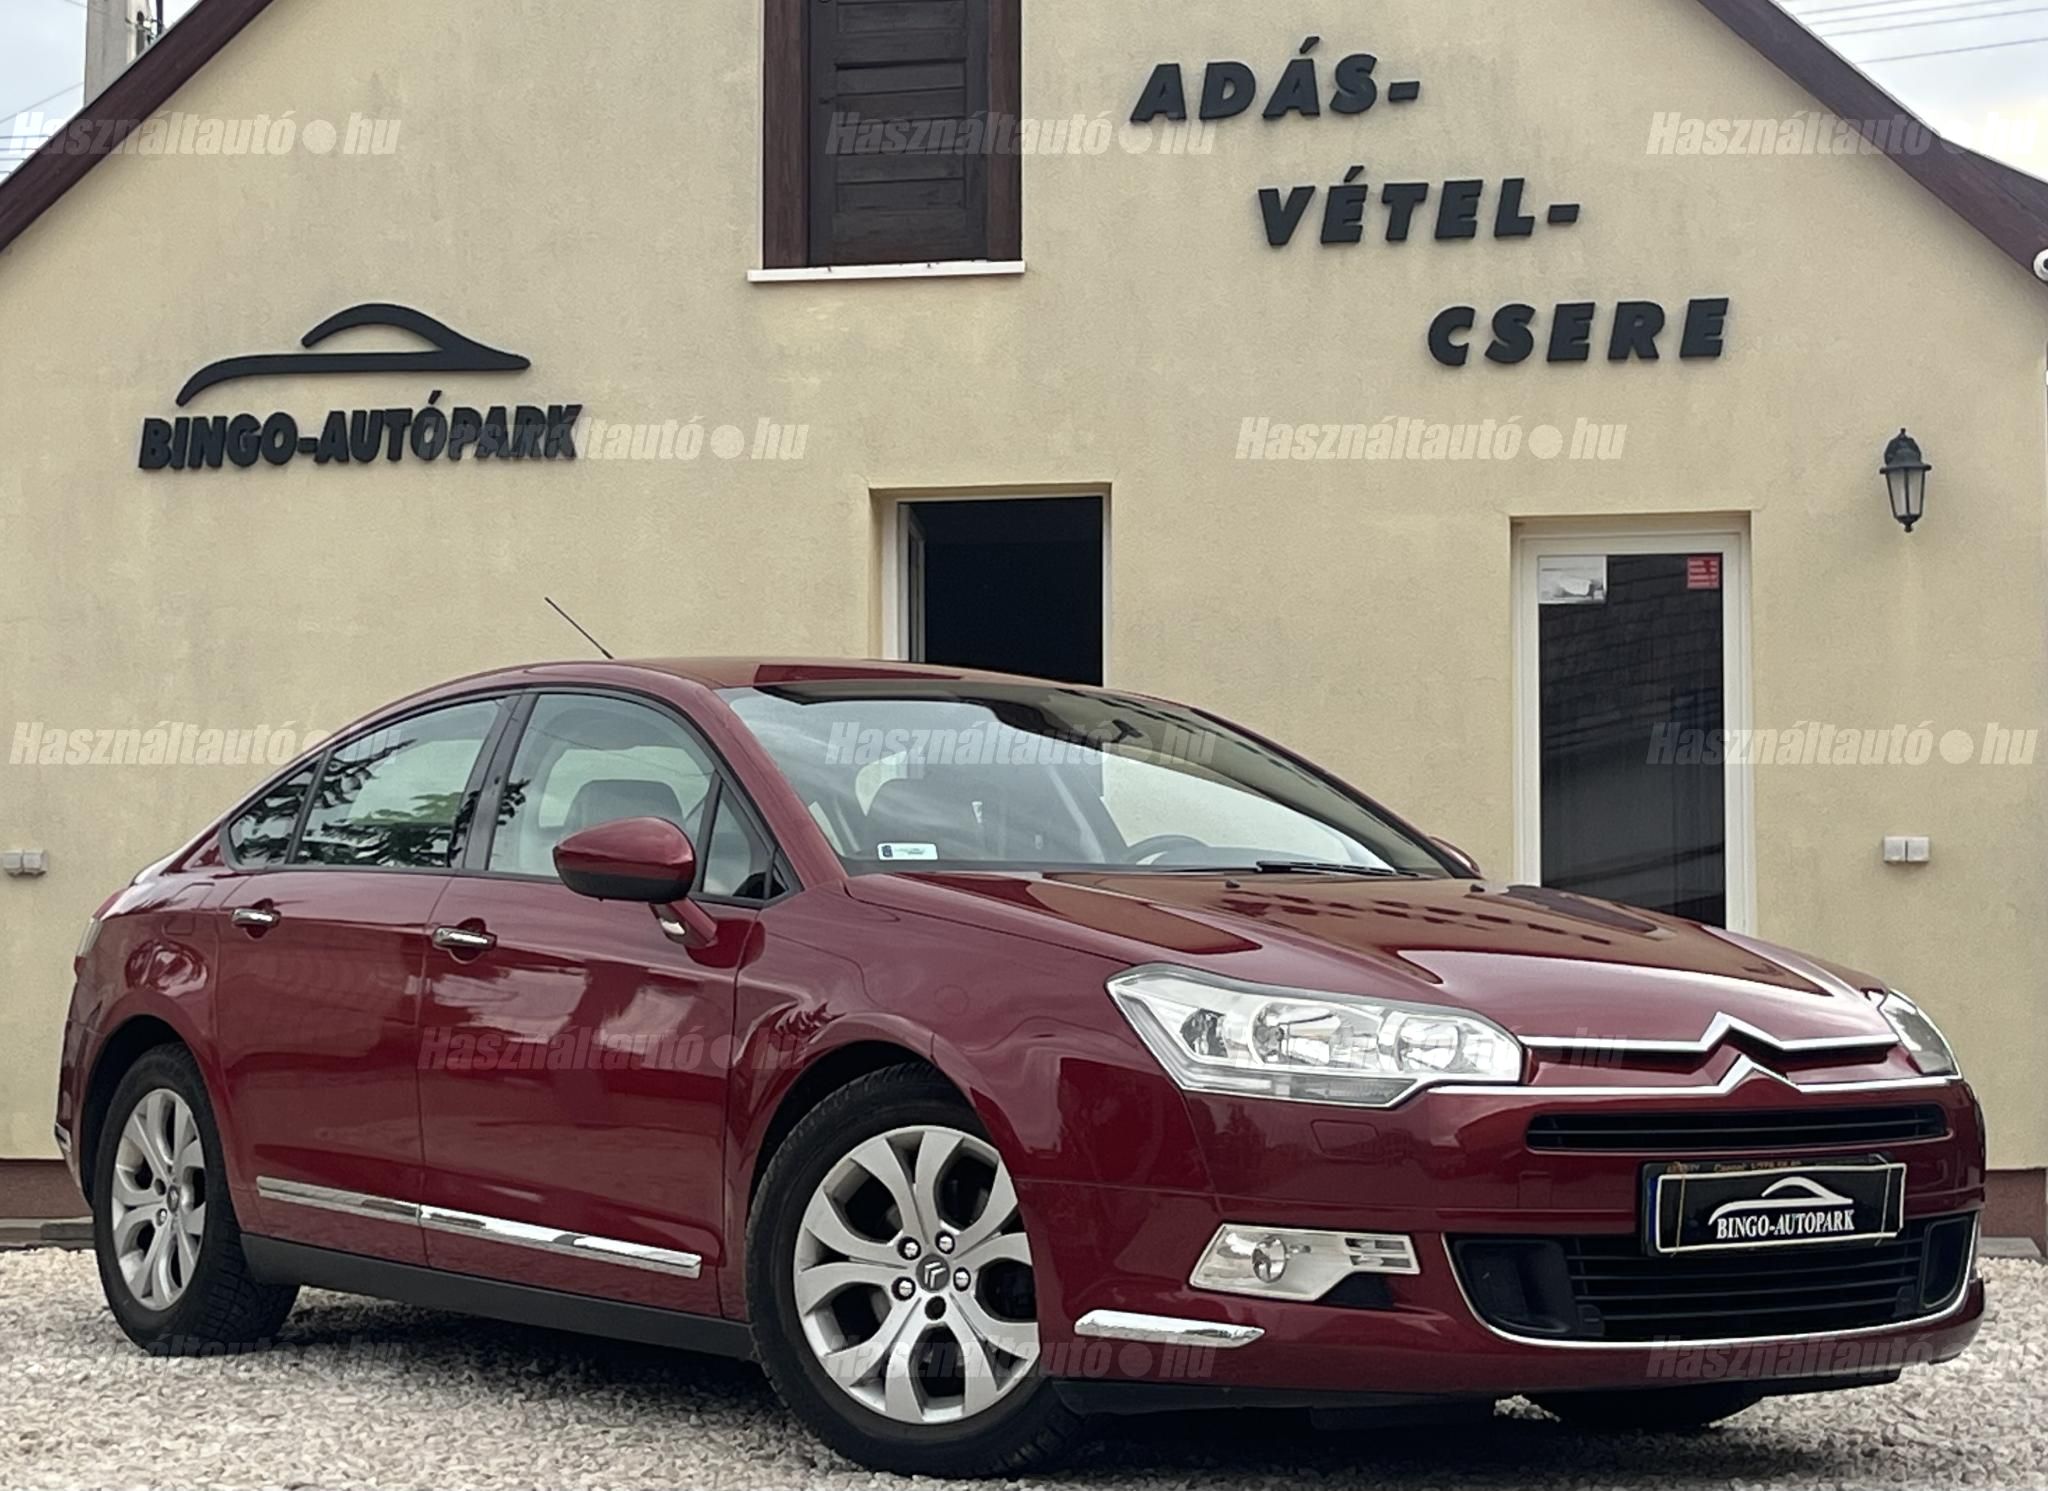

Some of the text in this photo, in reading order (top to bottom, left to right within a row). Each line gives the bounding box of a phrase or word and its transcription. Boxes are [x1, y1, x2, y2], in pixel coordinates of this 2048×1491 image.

[1129, 37, 1420, 122] ADÁS-
[1258, 166, 1580, 246] VÉTEL-
[1428, 298, 1729, 367] CSERE
[138, 391, 582, 470] BINGO-AUTÓPARK
[1716, 1209, 1855, 1239] BINGO-AUTOPARK
